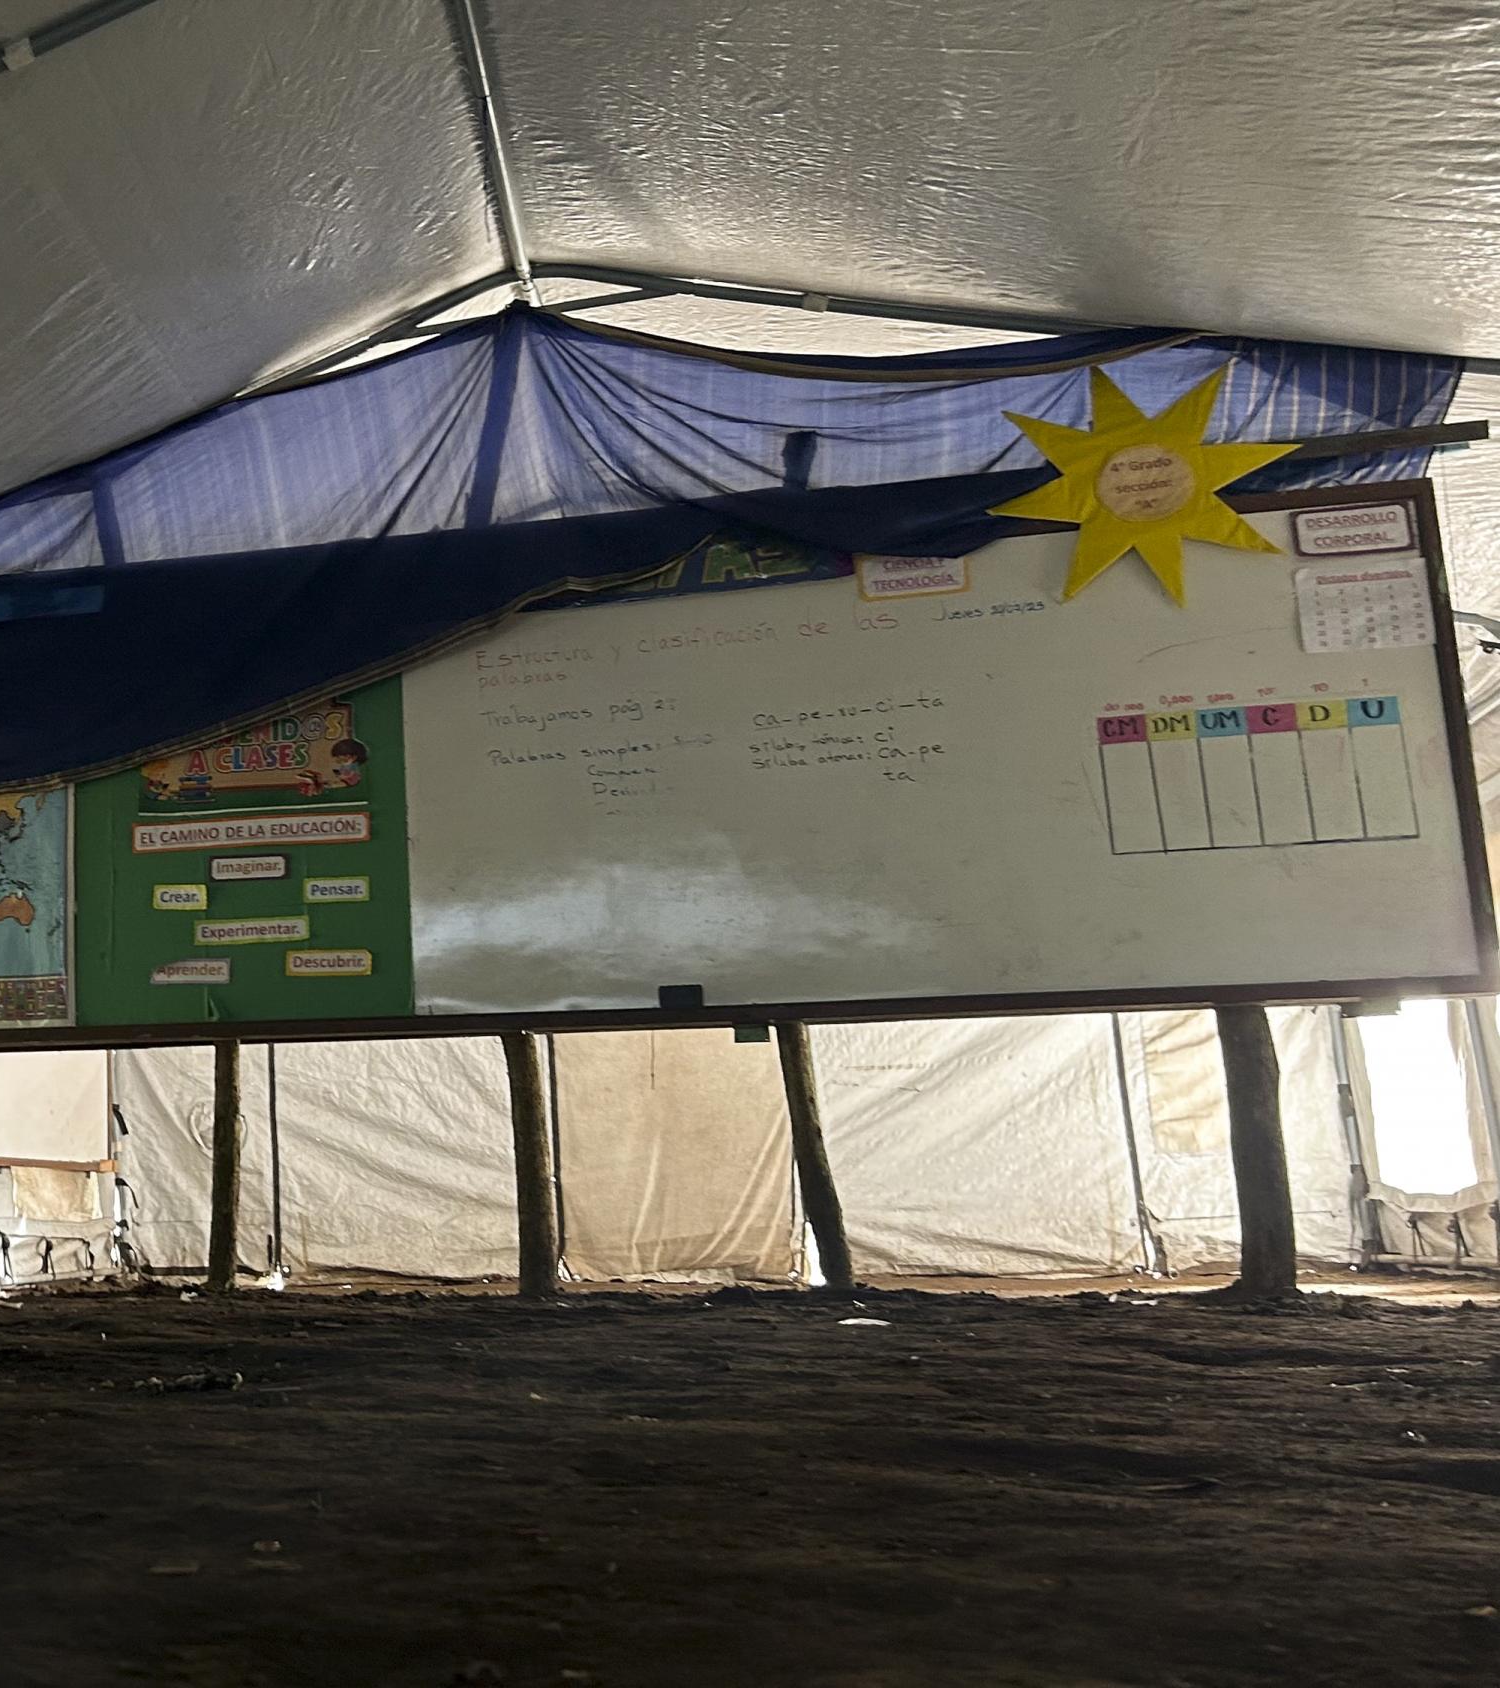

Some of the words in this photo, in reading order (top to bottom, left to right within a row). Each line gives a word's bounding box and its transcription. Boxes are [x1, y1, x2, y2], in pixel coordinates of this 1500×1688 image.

[1304, 510, 1397, 529] DESARROLLO
[1151, 714, 1192, 734] DM
[1200, 710, 1241, 730] UM
[1260, 706, 1282, 727] C
[1308, 703, 1331, 723] D
[1359, 698, 1386, 720] U
[186, 750, 208, 775] A
[214, 741, 309, 773] CLASES
[140, 831, 156, 846] EL
[159, 825, 219, 845] CAMINO
[225, 823, 244, 840] DE
[247, 822, 265, 838] LA
[270, 816, 362, 836] EDUCACIÓN:
[216, 860, 282, 876] Imaginar.
[159, 890, 200, 904] Crear.
[309, 882, 364, 897] Pensar.
[200, 922, 301, 940] Experimentar.
[292, 954, 366, 969] Descubrir.
[156, 963, 226, 978] Aprender.
